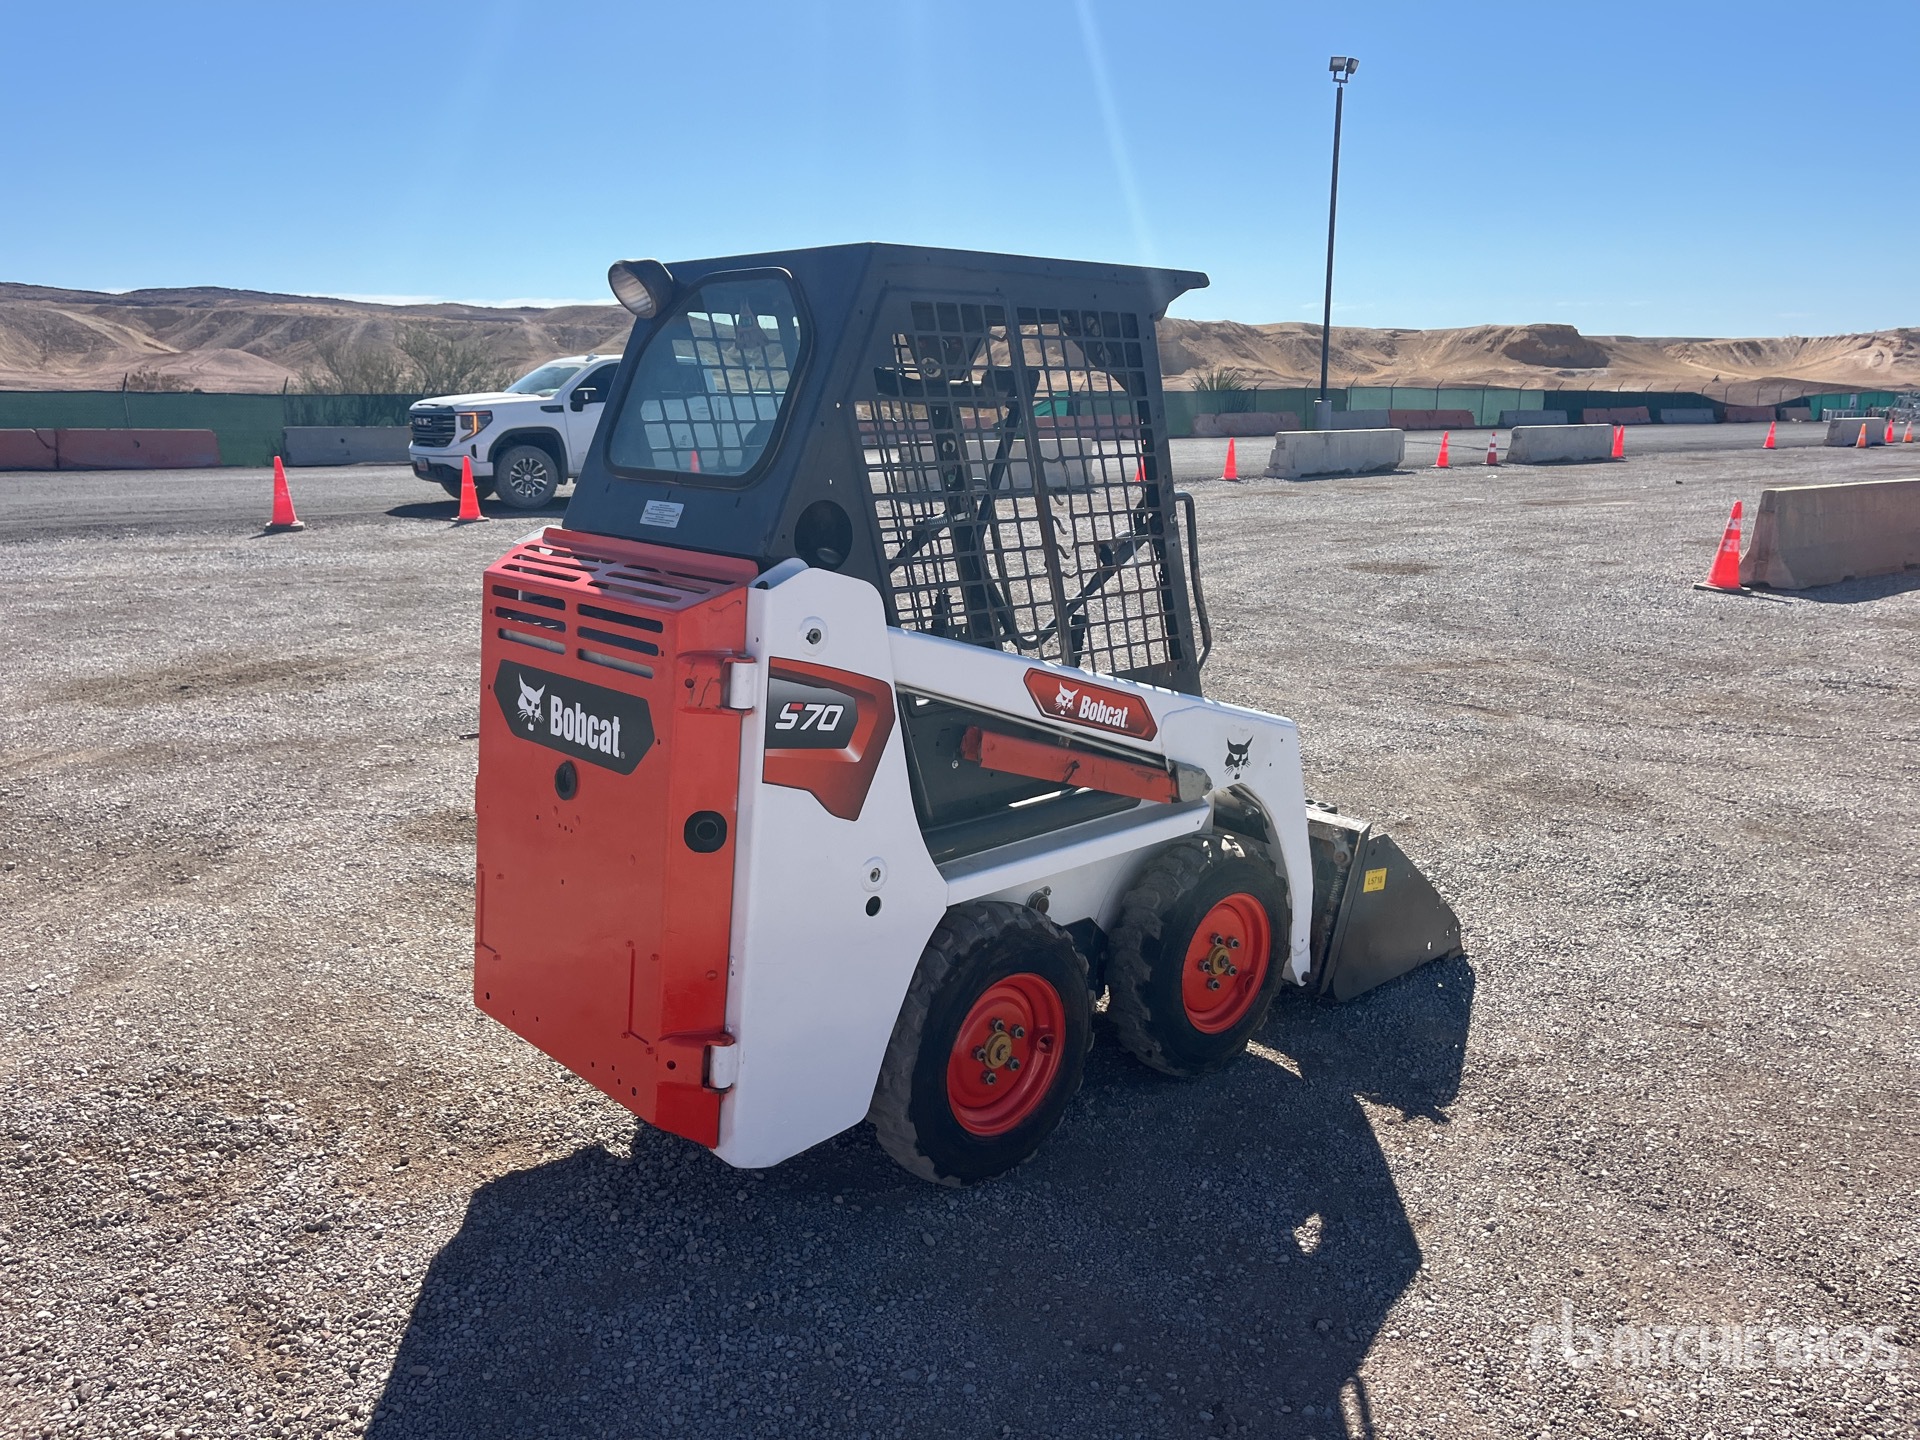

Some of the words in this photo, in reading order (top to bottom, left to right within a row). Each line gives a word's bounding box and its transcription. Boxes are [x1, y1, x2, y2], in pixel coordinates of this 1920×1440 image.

[550, 694, 621, 758] Bobcat
[774, 702, 845, 732] S70
[1078, 695, 1129, 729] Bobcat
